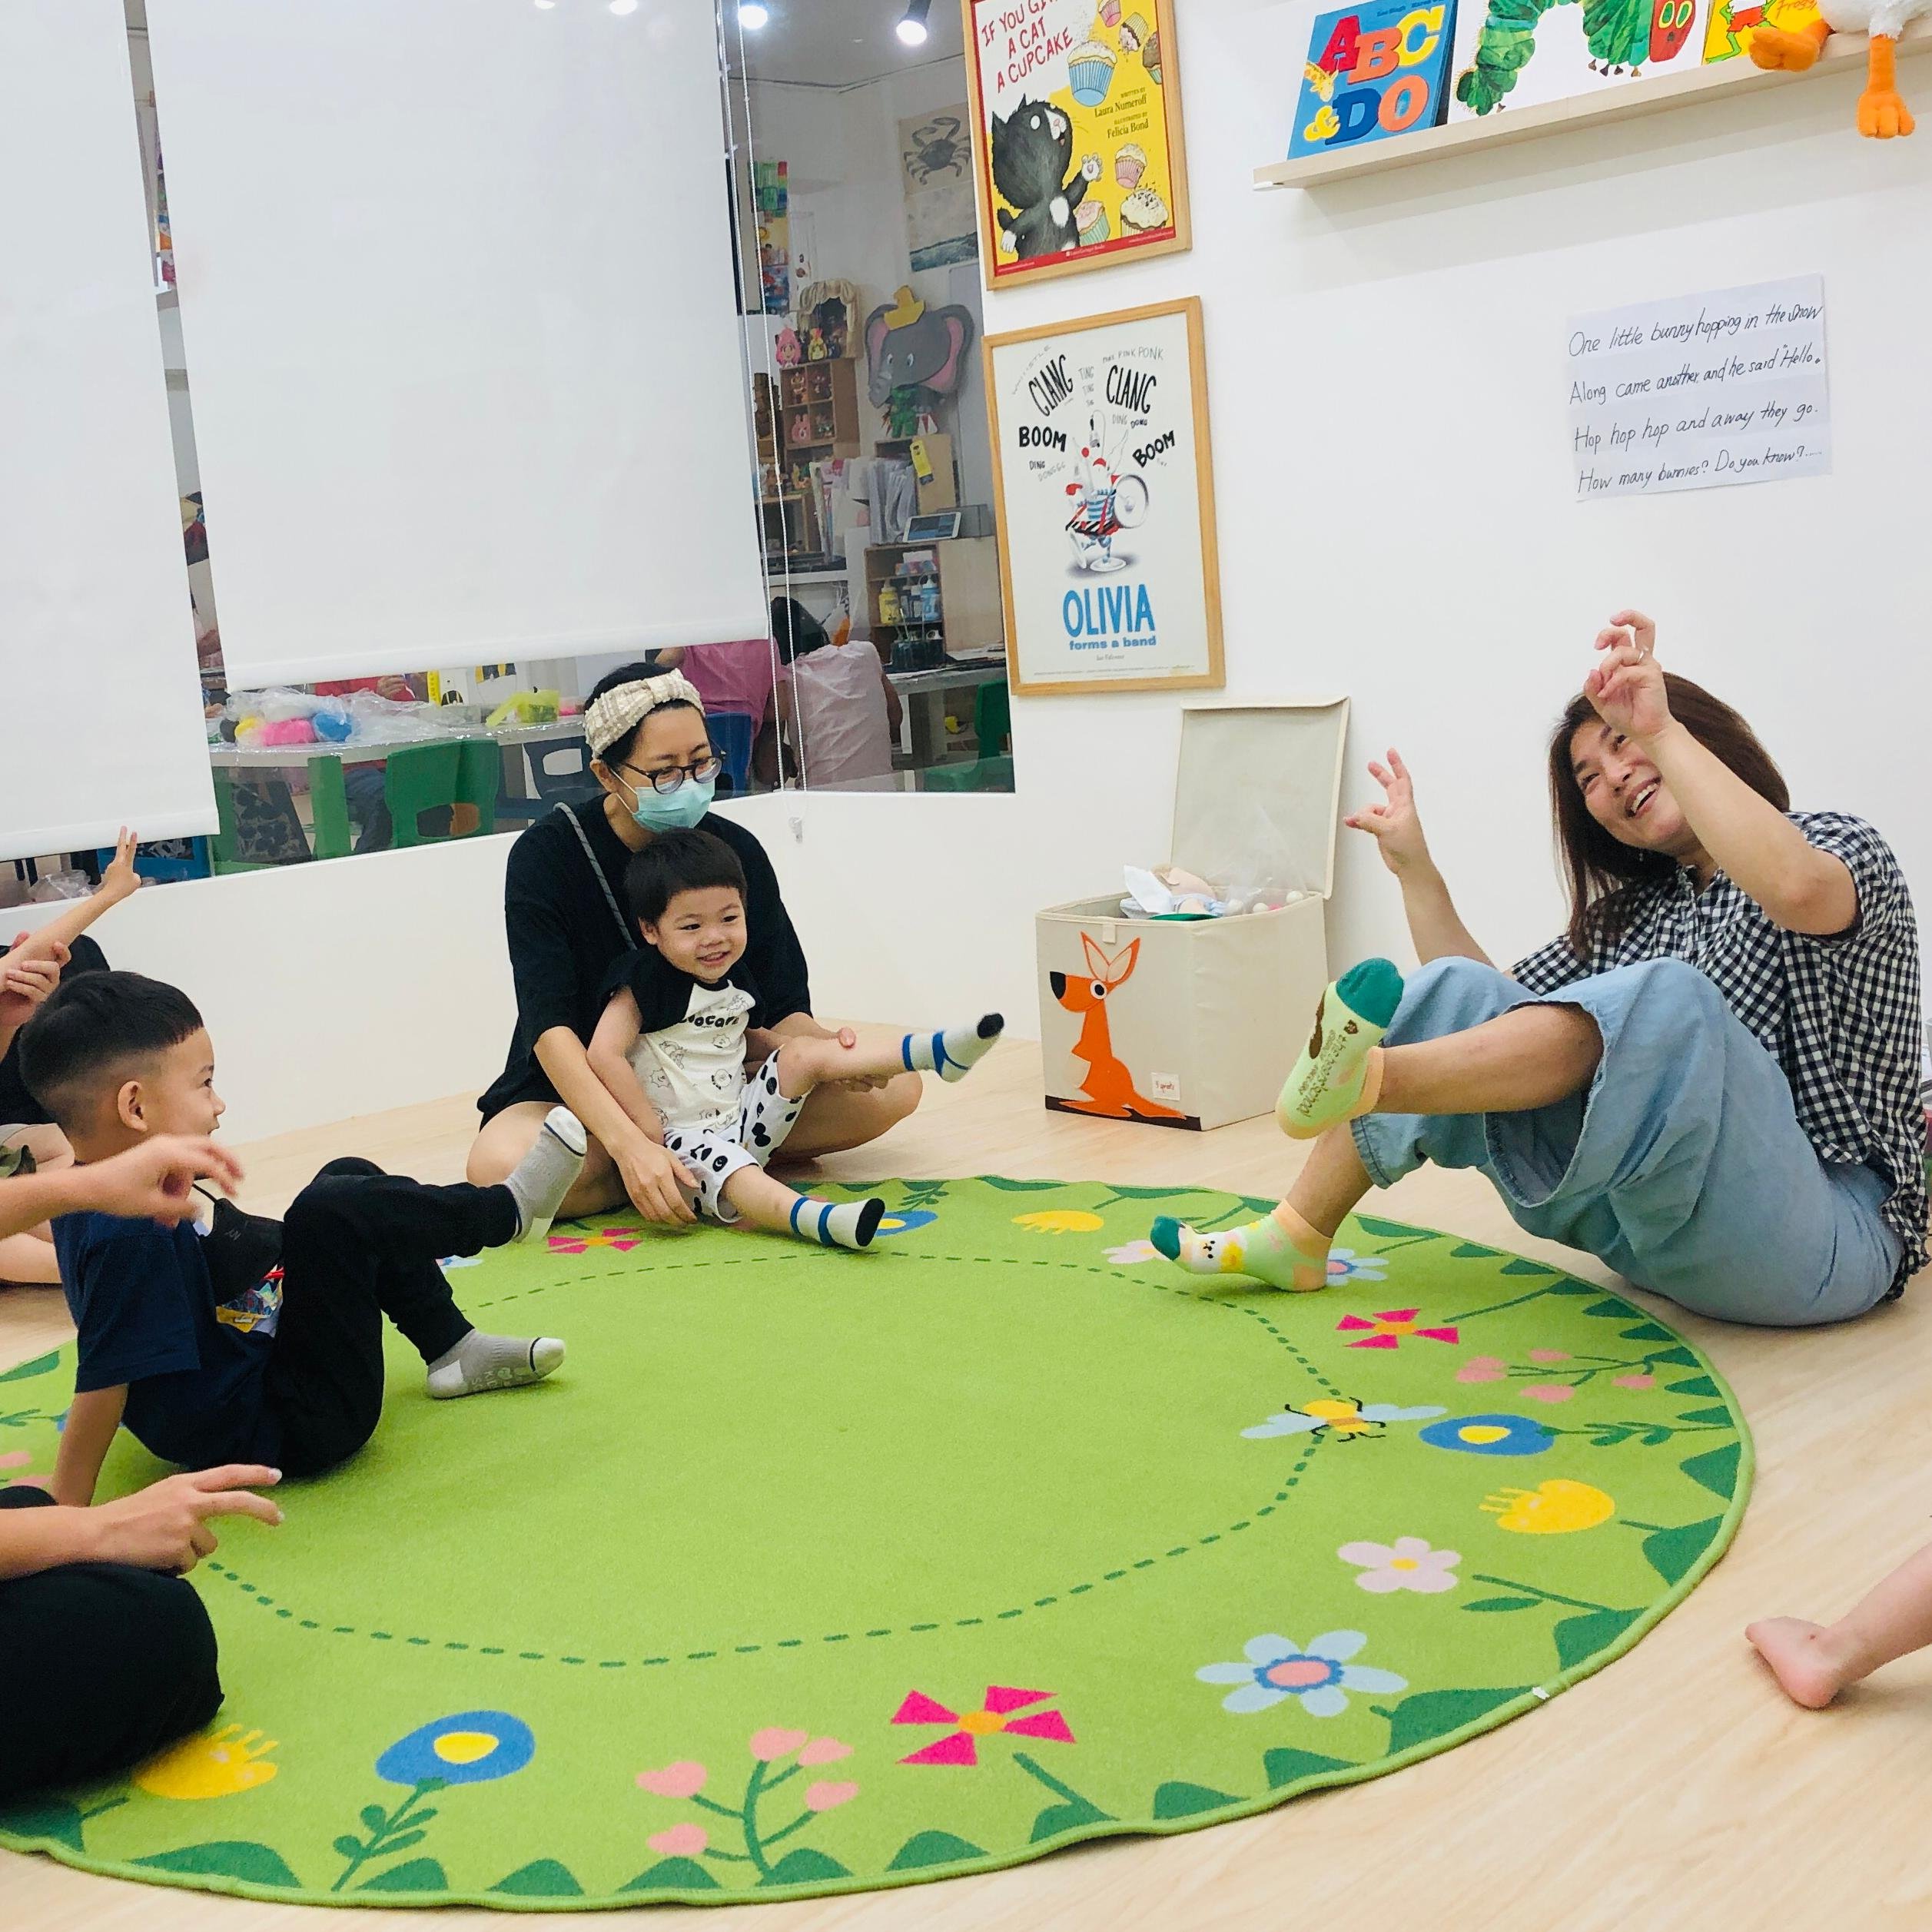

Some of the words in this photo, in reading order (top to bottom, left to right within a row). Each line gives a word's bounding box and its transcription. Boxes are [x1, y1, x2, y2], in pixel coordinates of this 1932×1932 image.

[981, 20, 995, 47] IF
[999, 3, 1025, 32] YOU
[1008, 37, 1016, 60] A
[1020, 16, 1046, 49] CAT
[1317, 5, 1446, 85] ABC
[998, 71, 1005, 93] A
[1008, 26, 1074, 83] CUPCAKE
[1094, 106, 1114, 118] Laura
[1114, 93, 1147, 112] Numeroff
[1107, 124, 1129, 139] Felicia
[1130, 118, 1149, 133] Bond
[1324, 75, 1429, 146] DO
[1569, 331, 1601, 357] One
[1609, 326, 1643, 350] little
[1651, 321, 1695, 343] bunny
[1695, 307, 1741, 344] hopping
[1744, 314, 1759, 330] in
[1766, 304, 1786, 325] the
[1028, 354, 1074, 417] CLANG
[1106, 364, 1157, 414] CLANG
[1569, 380, 1606, 406] Along
[1615, 379, 1651, 398] came
[1703, 357, 1728, 382] and
[1728, 355, 1746, 377] he
[1748, 348, 1780, 373] said
[1019, 426, 1067, 453] BOOM
[1132, 430, 1175, 468] BOOM
[1575, 425, 1602, 455] Hop
[1610, 422, 1636, 451] hop
[1642, 417, 1669, 448] hop
[1675, 407, 1711, 432] and
[1711, 411, 1754, 430] away
[1760, 400, 1788, 427] they
[1577, 467, 1613, 493] How
[1618, 470, 1653, 489] many
[1715, 449, 1734, 471] Do
[1733, 458, 1760, 473] you
[1063, 584, 1156, 637] OLIVIA
[1069, 640, 1107, 650] forms
[1123, 636, 1157, 647] band
